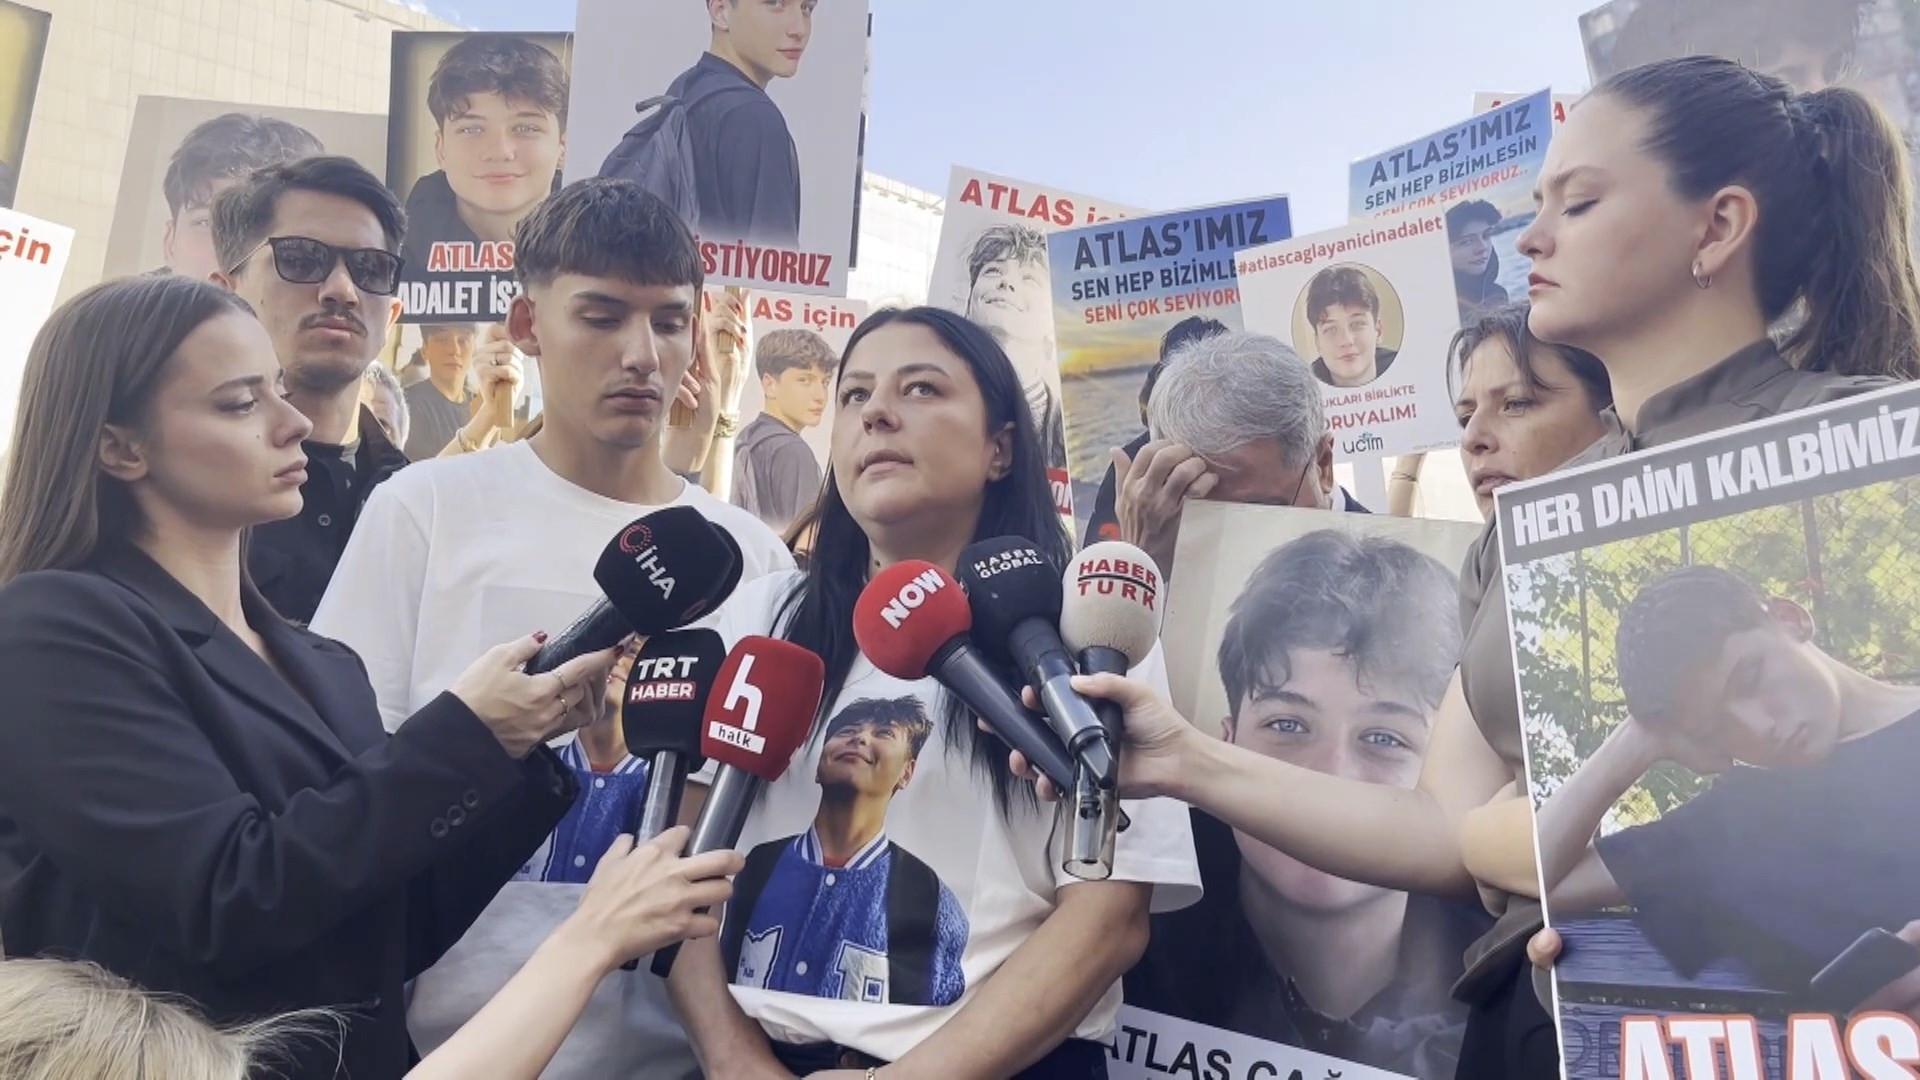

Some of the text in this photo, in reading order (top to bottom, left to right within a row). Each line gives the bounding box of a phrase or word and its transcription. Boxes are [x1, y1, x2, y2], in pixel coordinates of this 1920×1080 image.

[1369, 104, 1531, 187] ATLAS'IMIZ
[1364, 135, 1537, 210] SEN HEP BİZİMLESİN
[960, 178, 1074, 226] ATLAS
[428, 241, 515, 272] ATLAS
[1074, 209, 1268, 271] ATLAS'IMIZ
[1238, 215, 1443, 275] #atlascaglayanicinadalet
[1072, 258, 1238, 300] SEN HEP BİZİMLE
[397, 281, 482, 314] ADALET
[1084, 287, 1240, 324] SENİ ÇOK SEVİYOR
[803, 303, 855, 331] için
[1364, 384, 1416, 402] BİRLİKTE
[1511, 404, 1920, 546] HER DAİM KALBİMİZ
[635, 545, 675, 600] İHA
[974, 548, 1038, 571] HABER
[980, 557, 1042, 578] GLOBAL
[1079, 559, 1156, 589] HABER
[880, 568, 945, 630] NOW
[638, 656, 699, 681] TRT
[630, 682, 693, 701] HABER
[718, 725, 752, 748] halk
